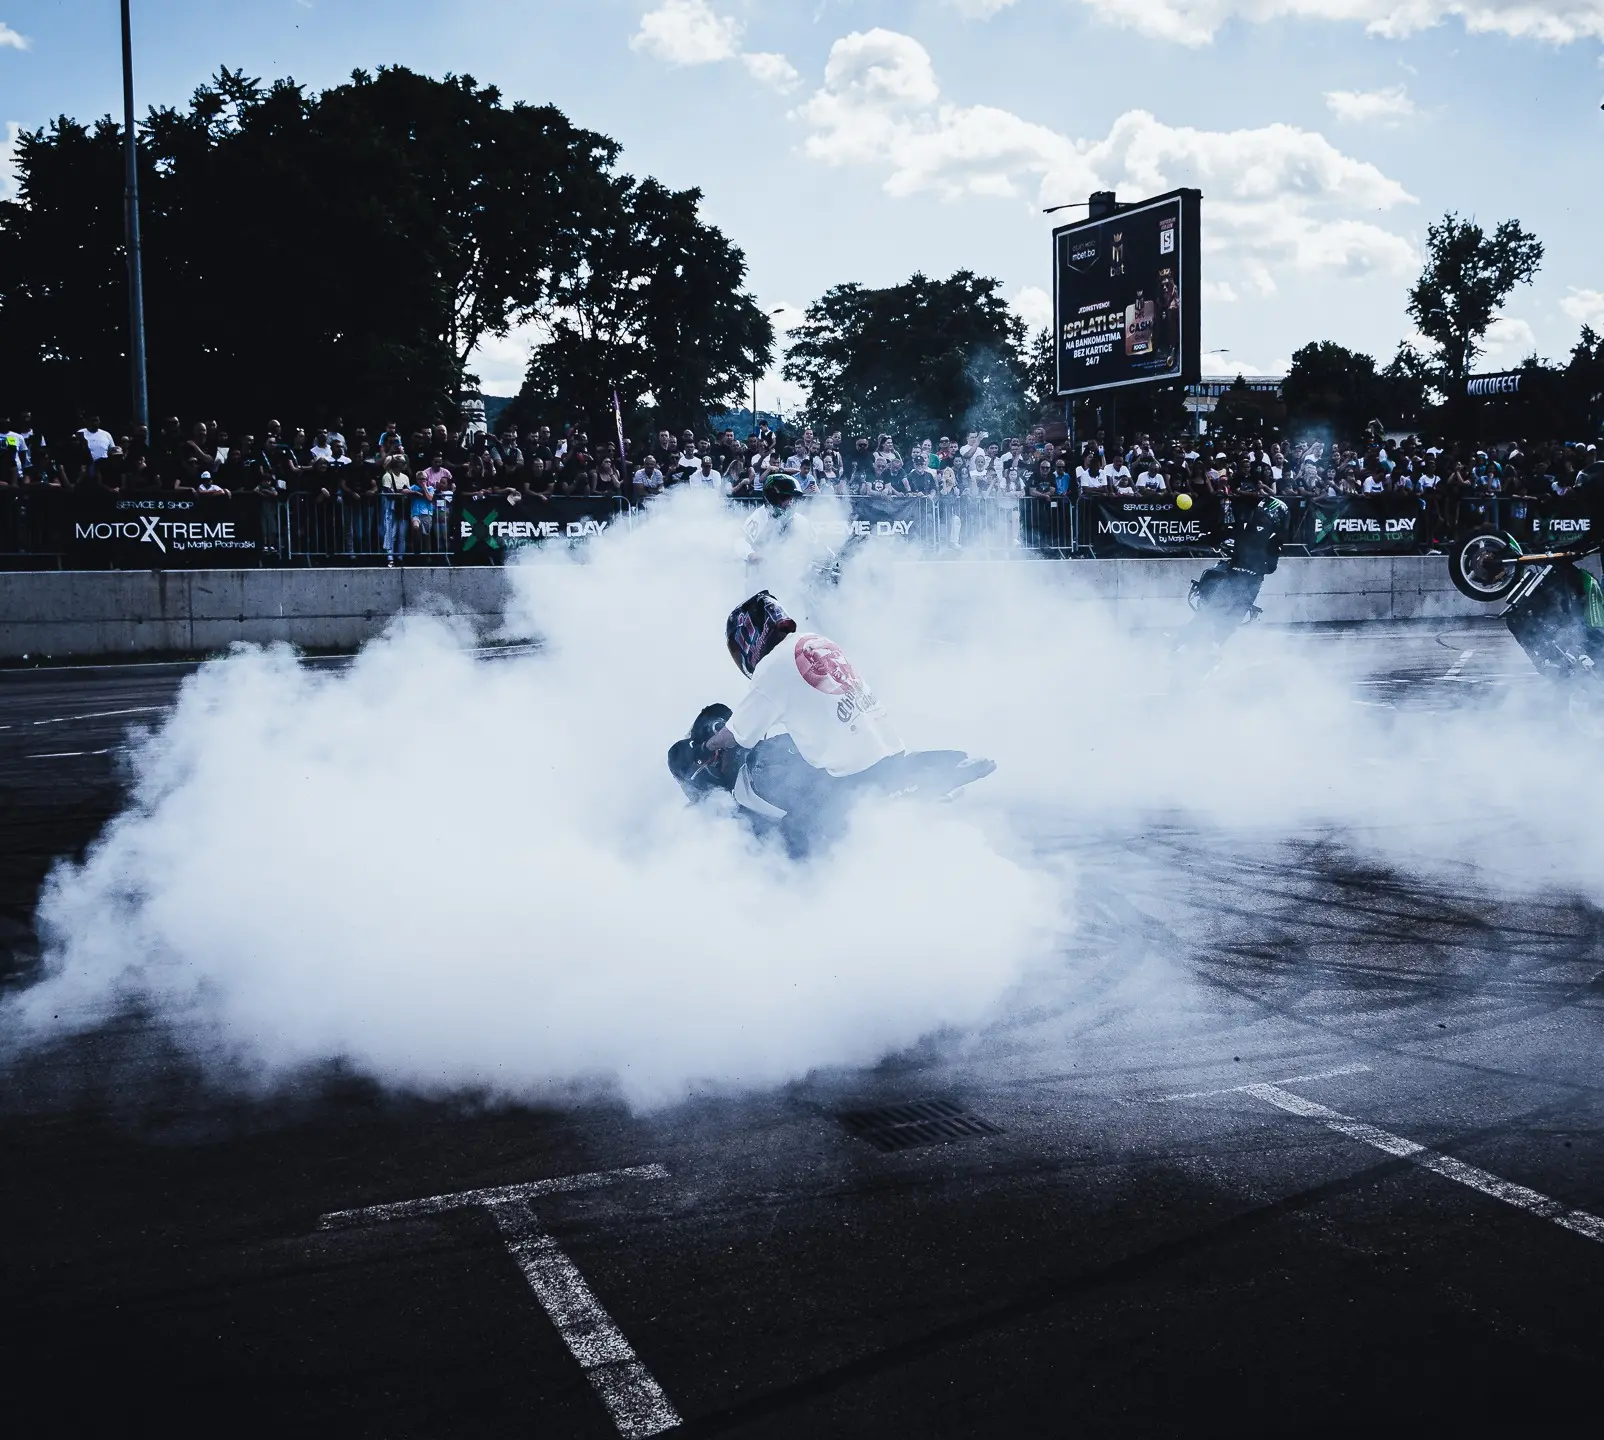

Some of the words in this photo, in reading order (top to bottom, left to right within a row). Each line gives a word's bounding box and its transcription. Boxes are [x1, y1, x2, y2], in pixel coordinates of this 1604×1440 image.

[1063, 315, 1107, 340] ISPLATI
[1108, 311, 1125, 330] SE
[1065, 340, 1075, 350] NA
[1075, 331, 1122, 346] BANKOMATIMA
[1073, 349, 1085, 358] BEZ
[1085, 343, 1113, 356] KARTICE
[1085, 355, 1100, 366] 24/7
[1467, 375, 1521, 395] MOTOFEST
[116, 501, 155, 509] SERVICE
[158, 501, 164, 509] &
[167, 501, 194, 509] SHOP
[1123, 503, 1148, 511] SERVICE
[1155, 503, 1173, 511] SHOP
[566, 520, 608, 537] DAY
[876, 520, 913, 536] DAY
[1385, 518, 1416, 532] DAY
[173, 541, 185, 550] by
[1158, 535, 1167, 543] by
